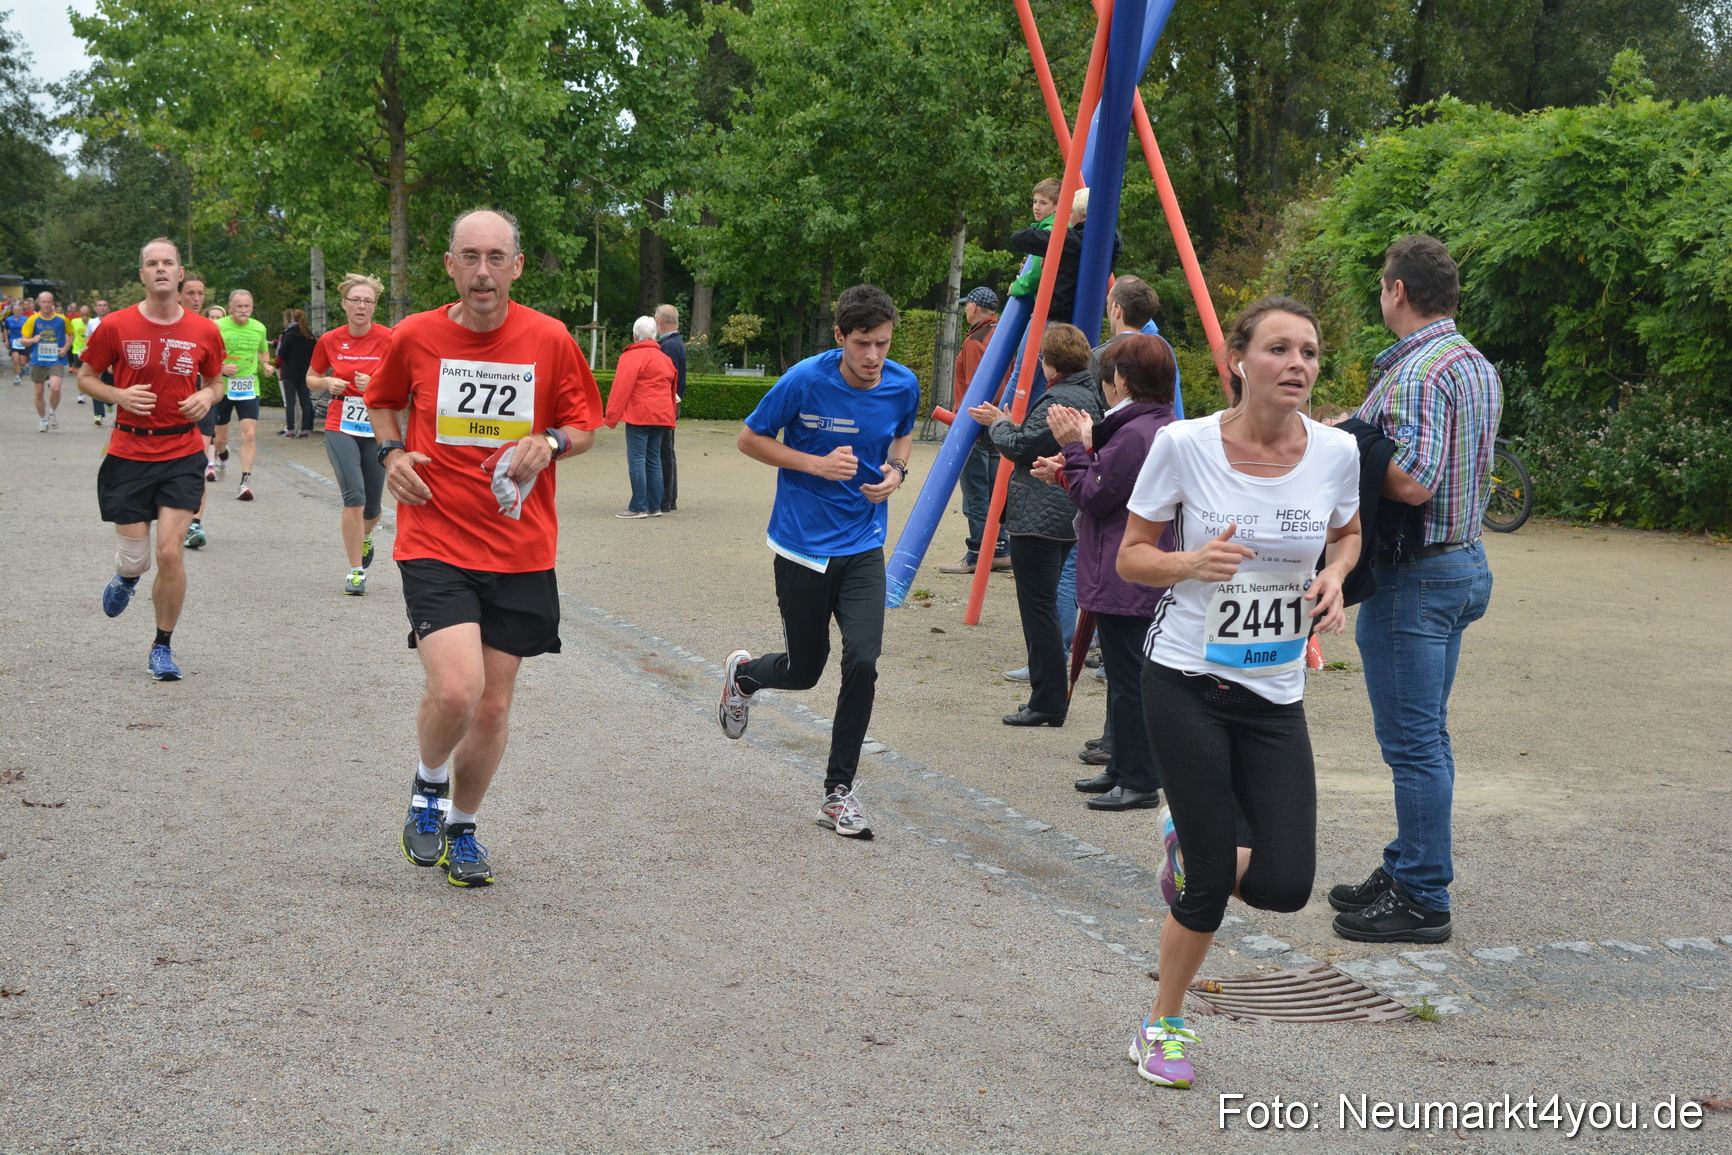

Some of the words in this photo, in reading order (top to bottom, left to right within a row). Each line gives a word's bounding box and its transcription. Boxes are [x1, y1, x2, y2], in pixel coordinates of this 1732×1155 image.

[442, 367, 473, 378] PARTL
[475, 370, 520, 381] Neumarkt
[231, 380, 253, 391] 2050
[457, 381, 517, 416] 272
[469, 422, 500, 436] Hans
[1201, 510, 1260, 525] PEUGEOT
[1275, 509, 1312, 520] HECK
[1204, 525, 1255, 539] MÜLER
[1280, 521, 1327, 532] DESIGN
[1249, 582, 1301, 593] Neumarkt
[1217, 596, 1302, 638] 2441
[1243, 649, 1277, 665] Anne
